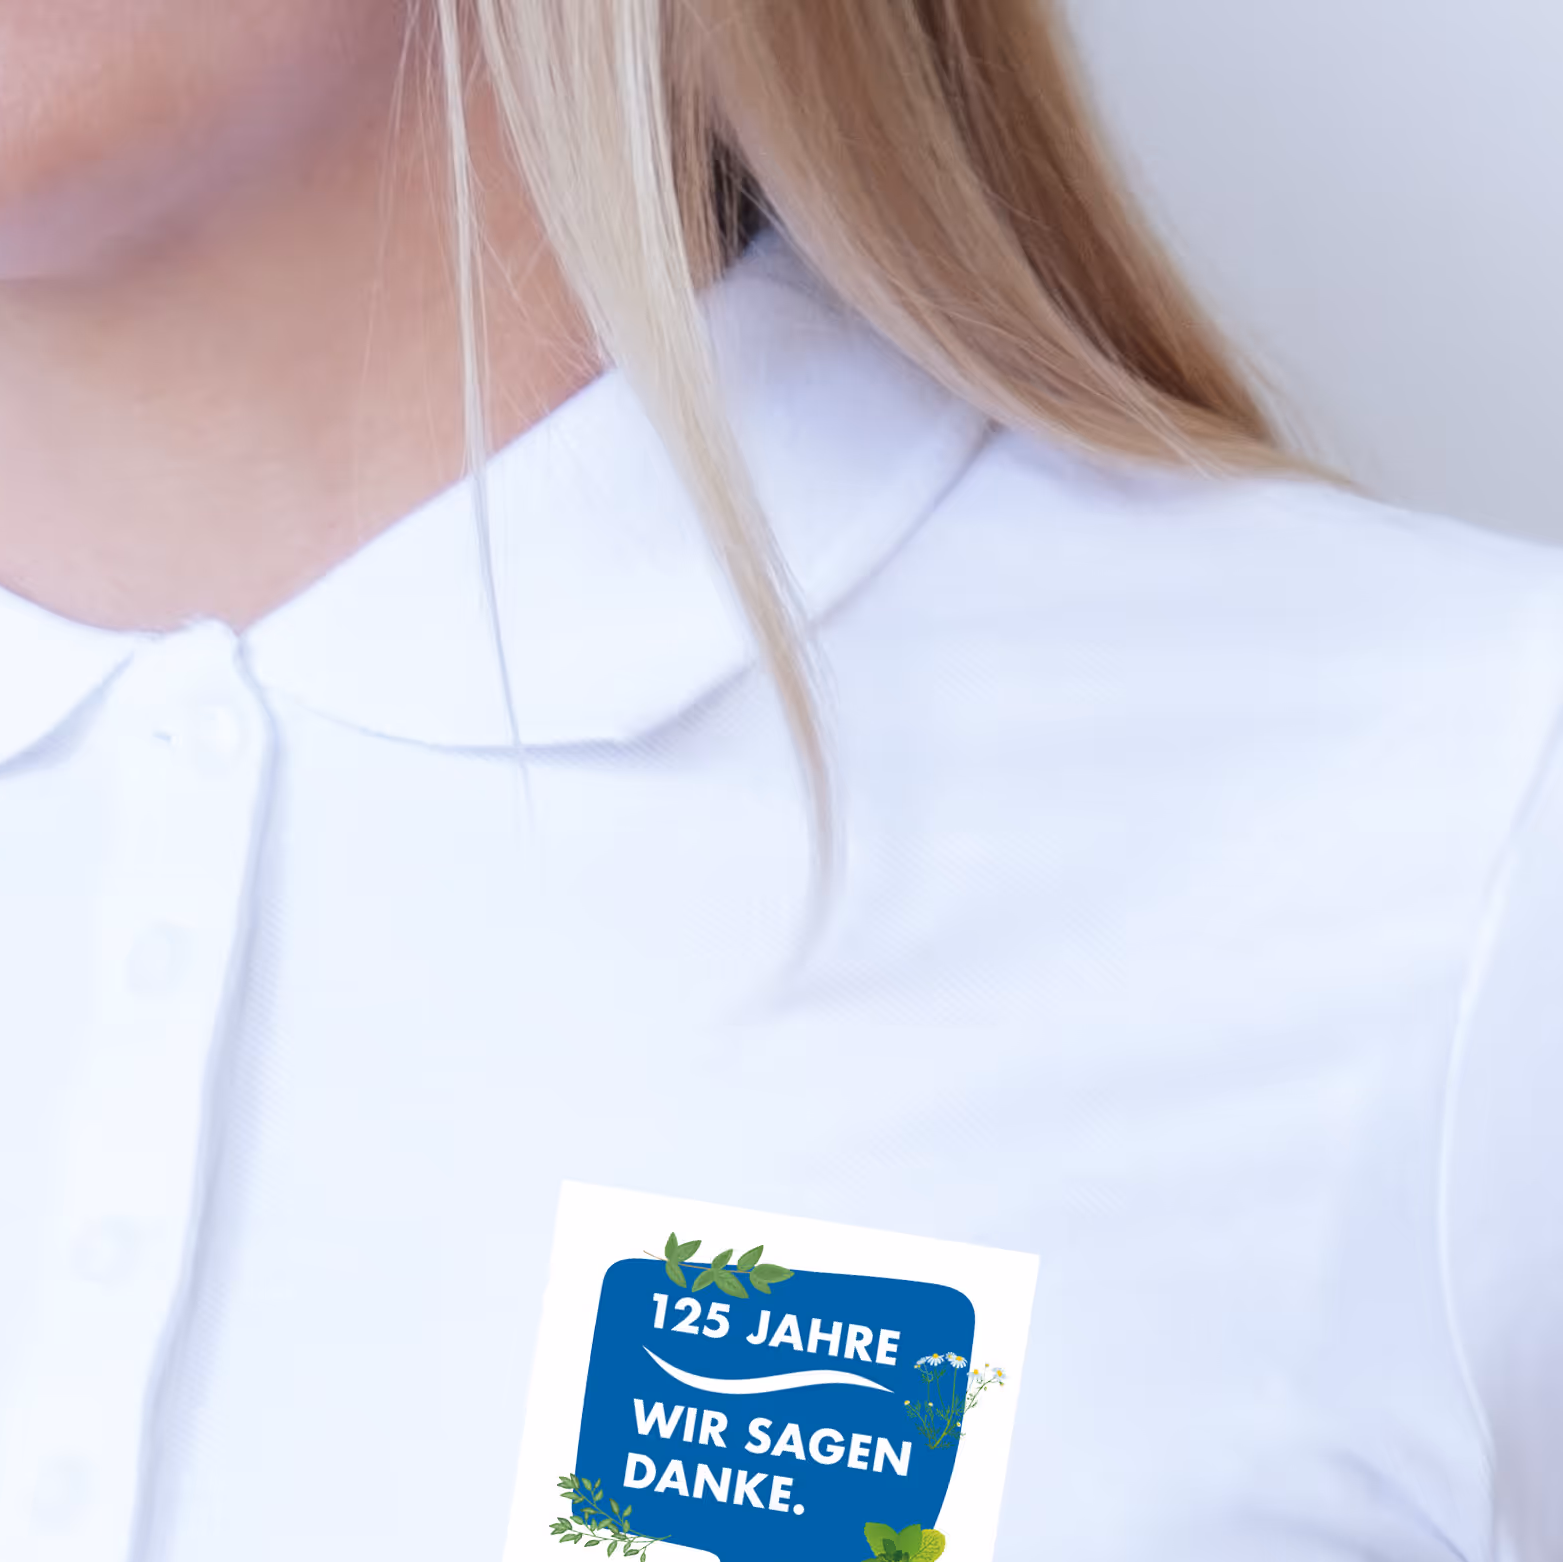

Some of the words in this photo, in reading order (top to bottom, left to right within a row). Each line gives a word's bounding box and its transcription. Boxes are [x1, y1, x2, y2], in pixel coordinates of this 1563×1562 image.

[653, 1293, 730, 1338] 125
[746, 1310, 900, 1365] JAHRE
[634, 1399, 727, 1448] WIR
[744, 1418, 912, 1476] SAGEN
[624, 1452, 805, 1515] DANKE.
